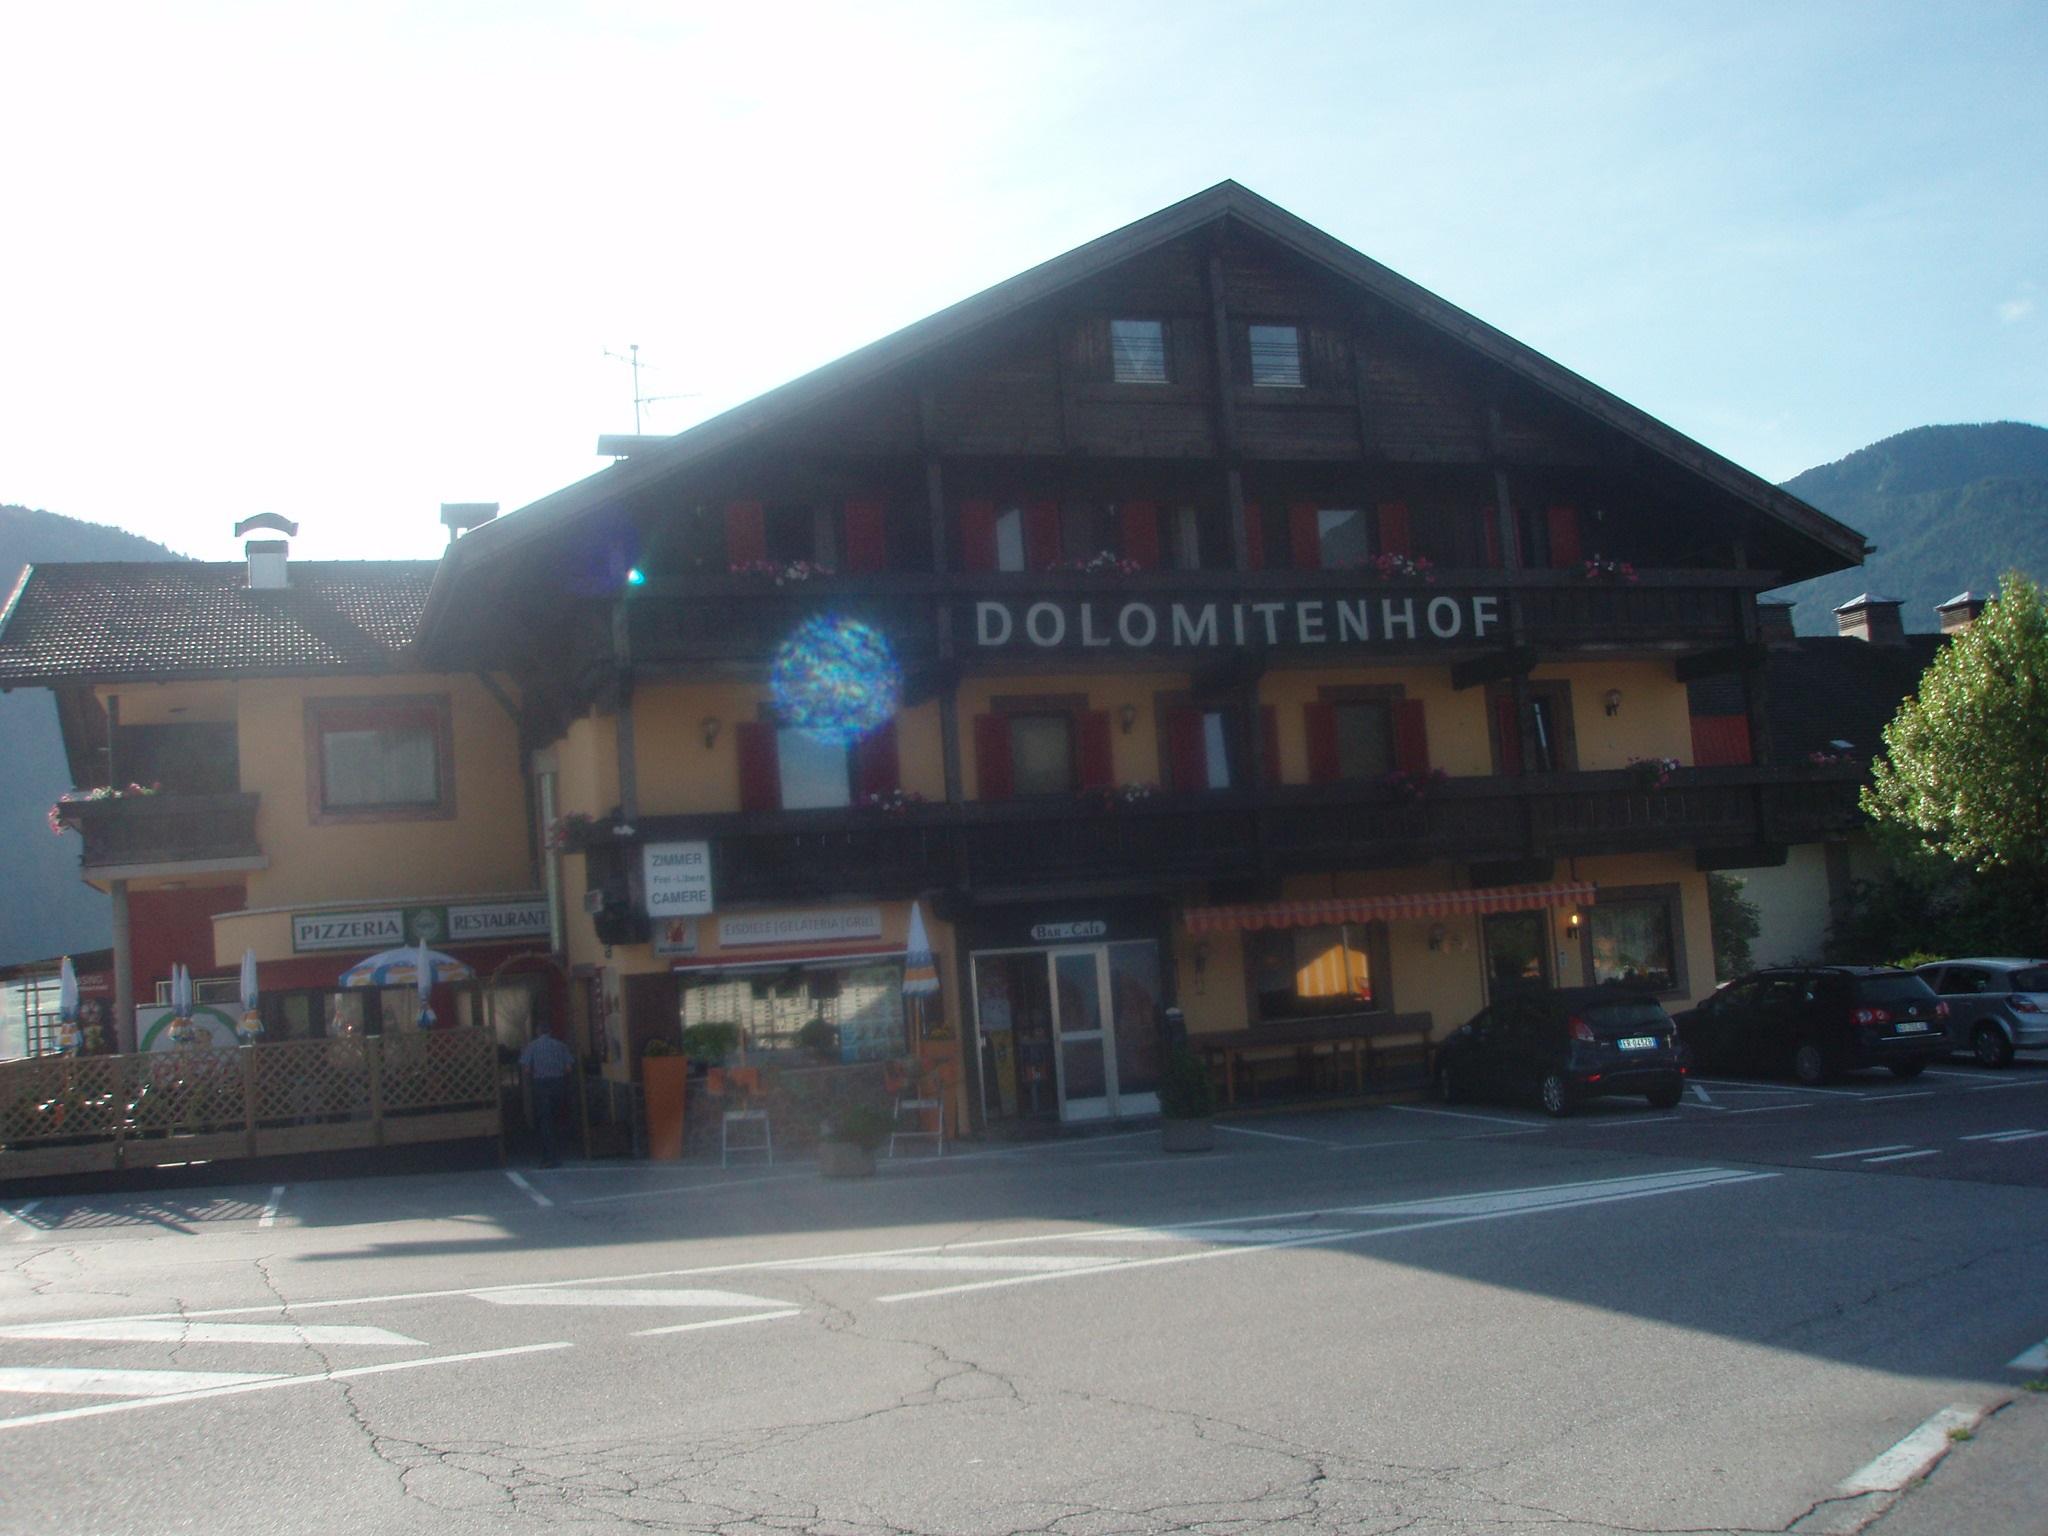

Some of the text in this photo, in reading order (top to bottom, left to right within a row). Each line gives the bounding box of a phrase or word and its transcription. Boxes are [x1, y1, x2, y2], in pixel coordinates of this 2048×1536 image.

[976, 597, 1498, 648] DOLOMITENHOF
[652, 853, 703, 867] ZIMMER
[652, 890, 707, 904] CAMERE
[301, 920, 400, 940] PIZZERIA
[454, 910, 547, 931] RESTAURANT
[725, 919, 771, 936] EISDIELE
[778, 917, 839, 933] GELATERIA
